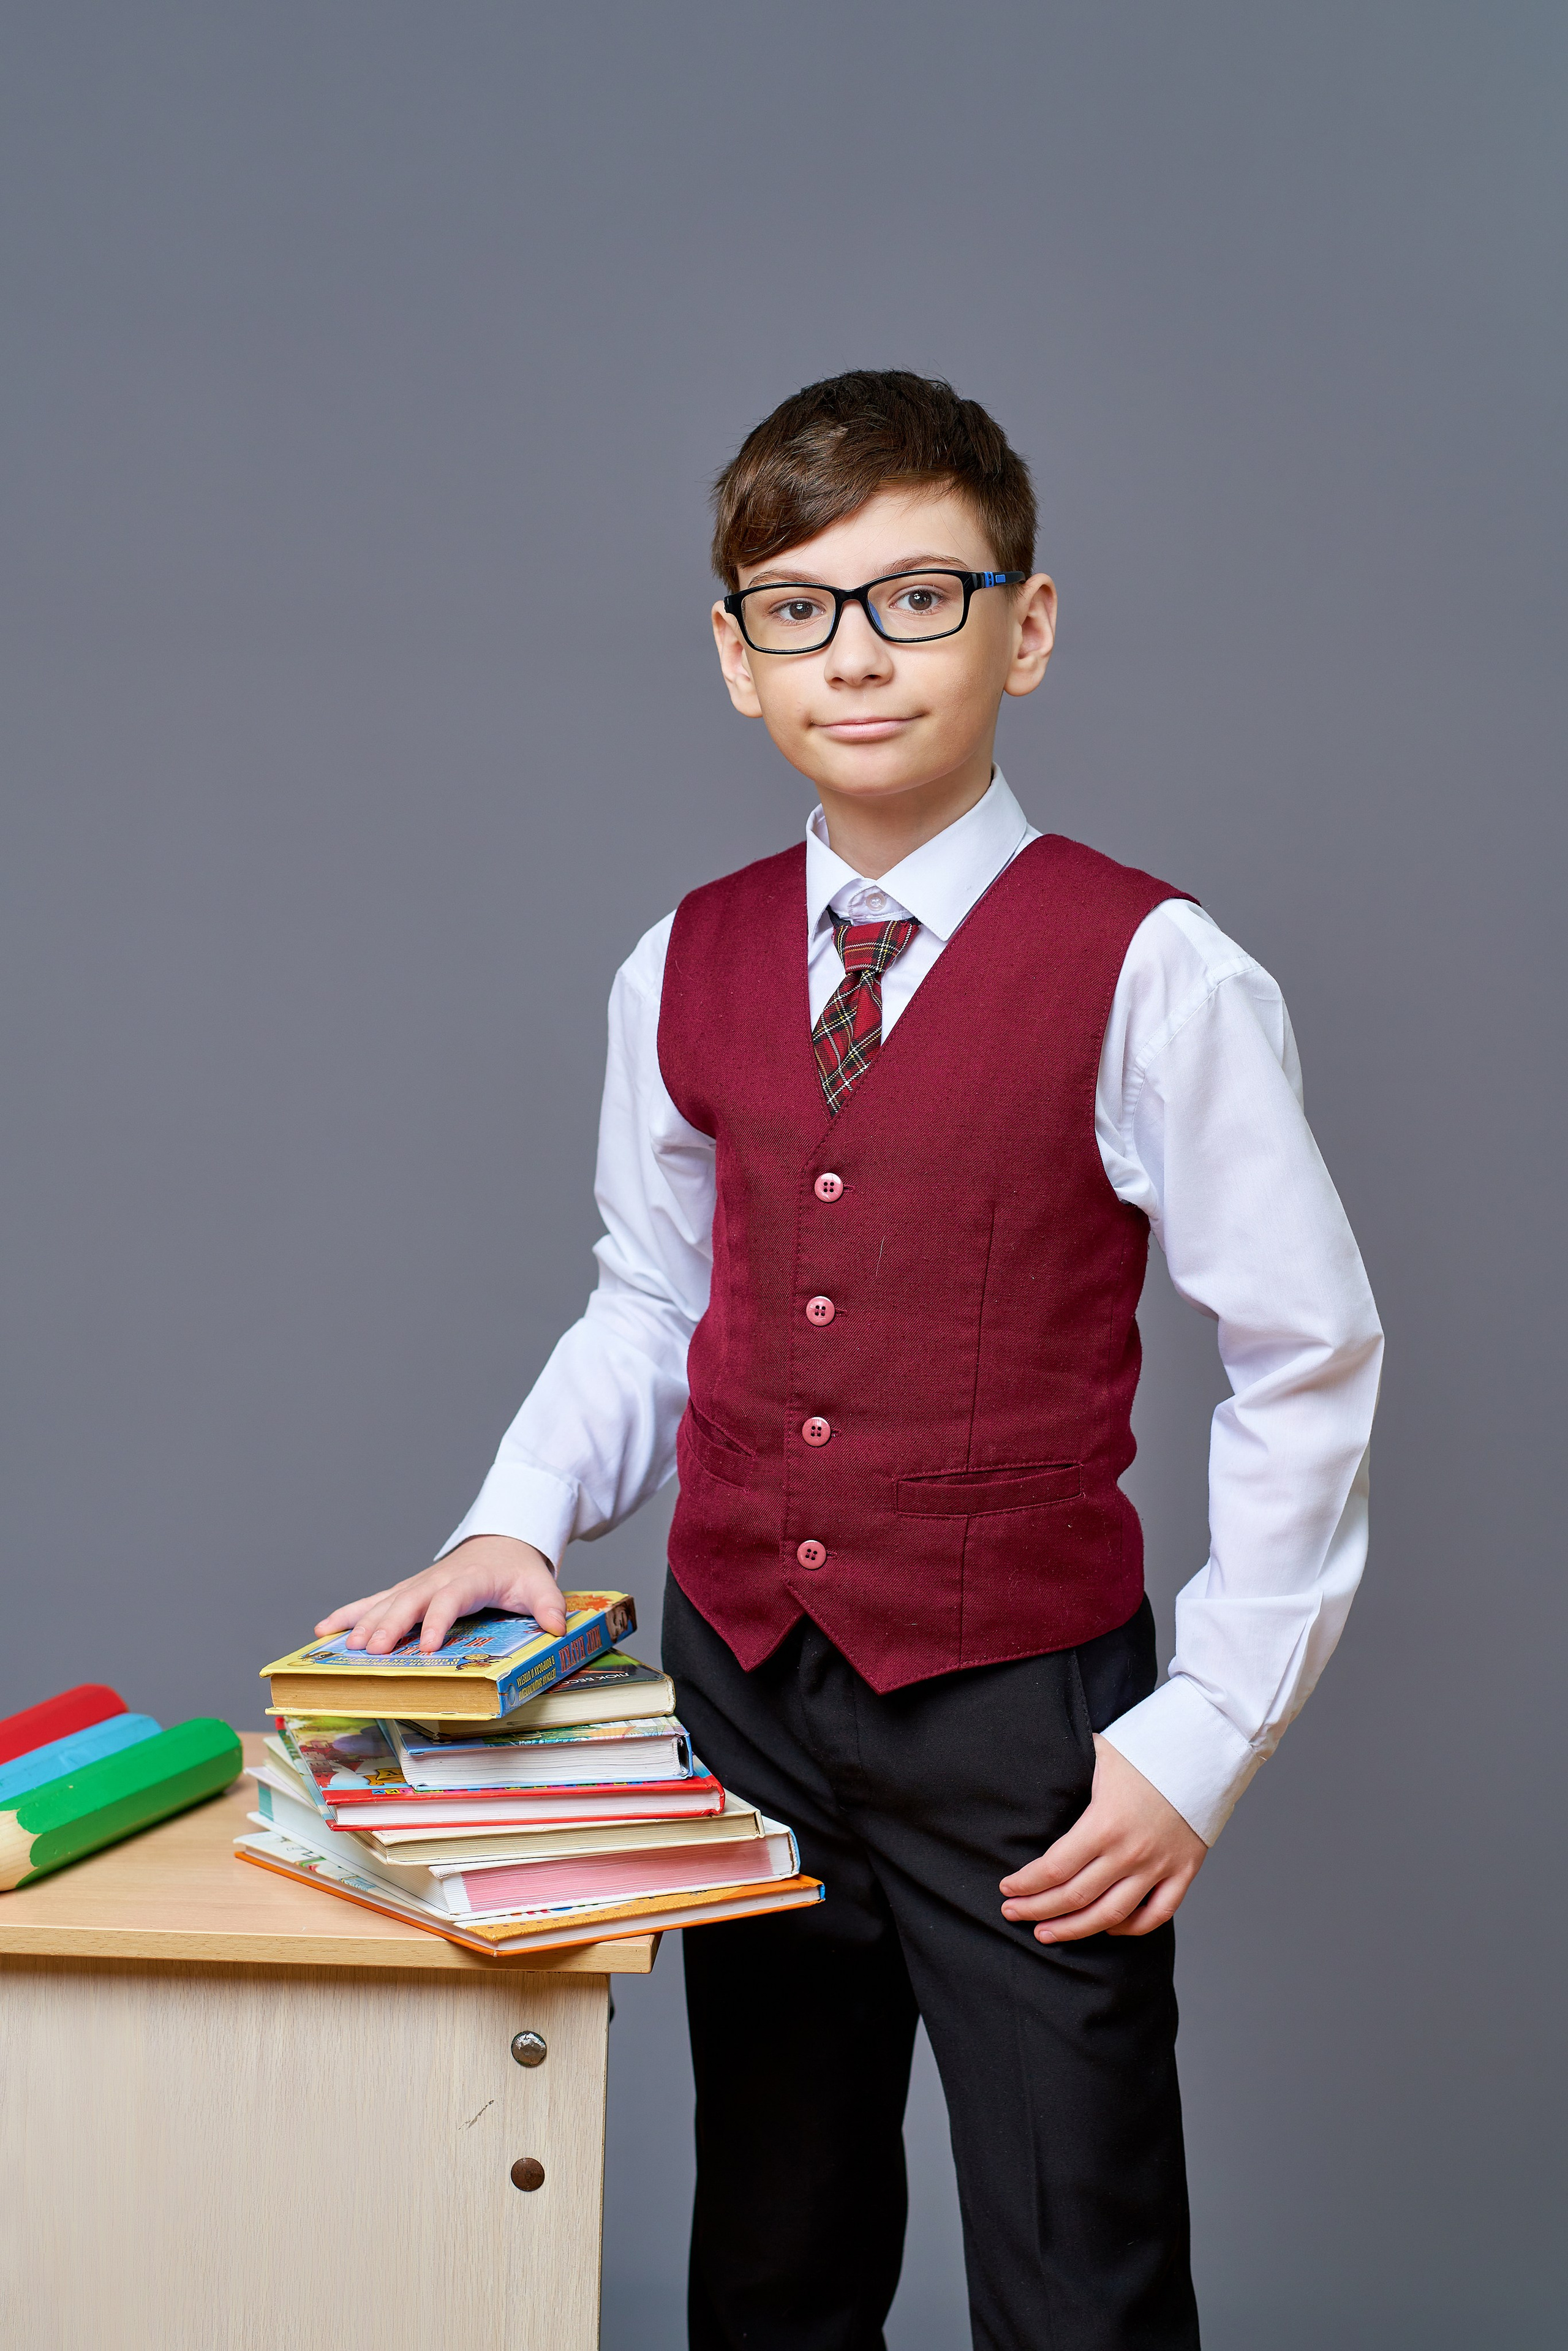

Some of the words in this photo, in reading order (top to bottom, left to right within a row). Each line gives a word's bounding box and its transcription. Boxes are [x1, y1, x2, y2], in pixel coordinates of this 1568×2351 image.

[586, 1625, 602, 1655] МИР
[559, 1636, 586, 1674] НАУКИ
[534, 1657, 552, 1677] ВОПРОСАХ
[543, 1667, 556, 1685] ДЕТСКАЯ
[516, 1670, 532, 1688] ОТВЕТАХ
[518, 1677, 543, 1702] ЭНЦИКЛОПЕДИЯ
